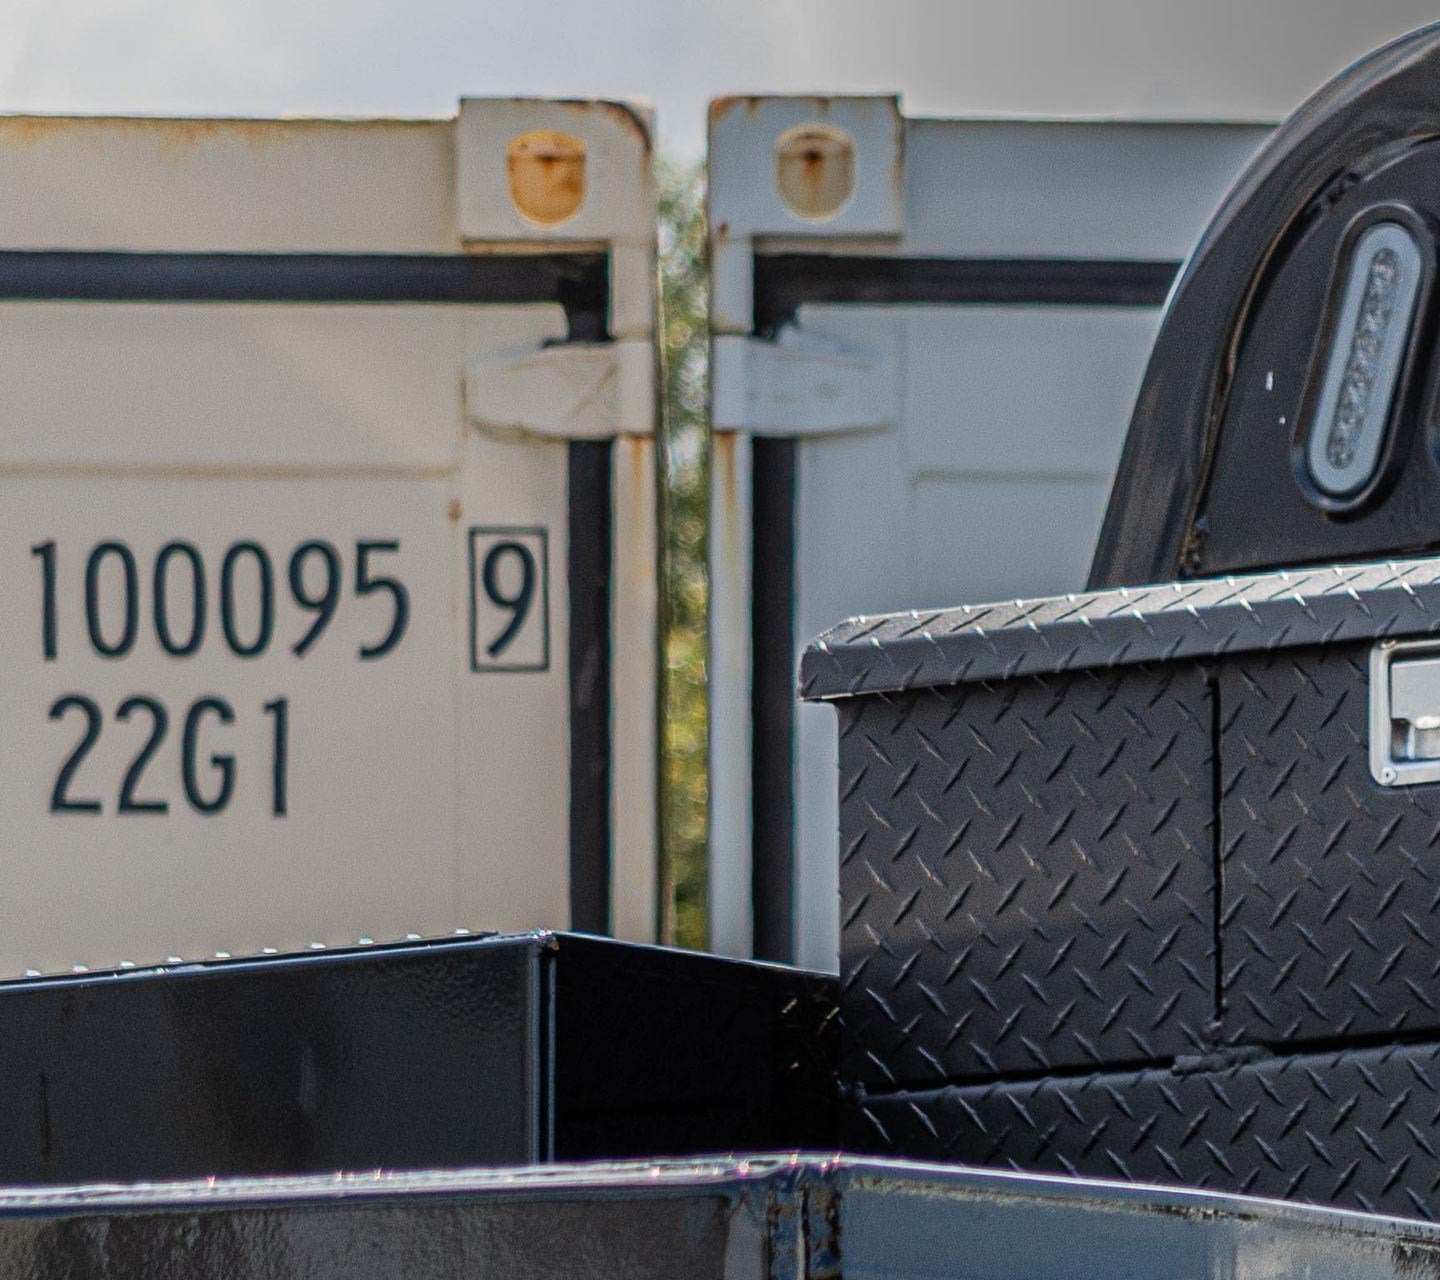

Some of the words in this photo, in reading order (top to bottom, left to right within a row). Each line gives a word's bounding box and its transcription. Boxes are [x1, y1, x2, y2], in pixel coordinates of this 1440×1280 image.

[30, 539, 411, 660] 100095
[481, 541, 537, 658] 9
[48, 694, 289, 816] 22G1
